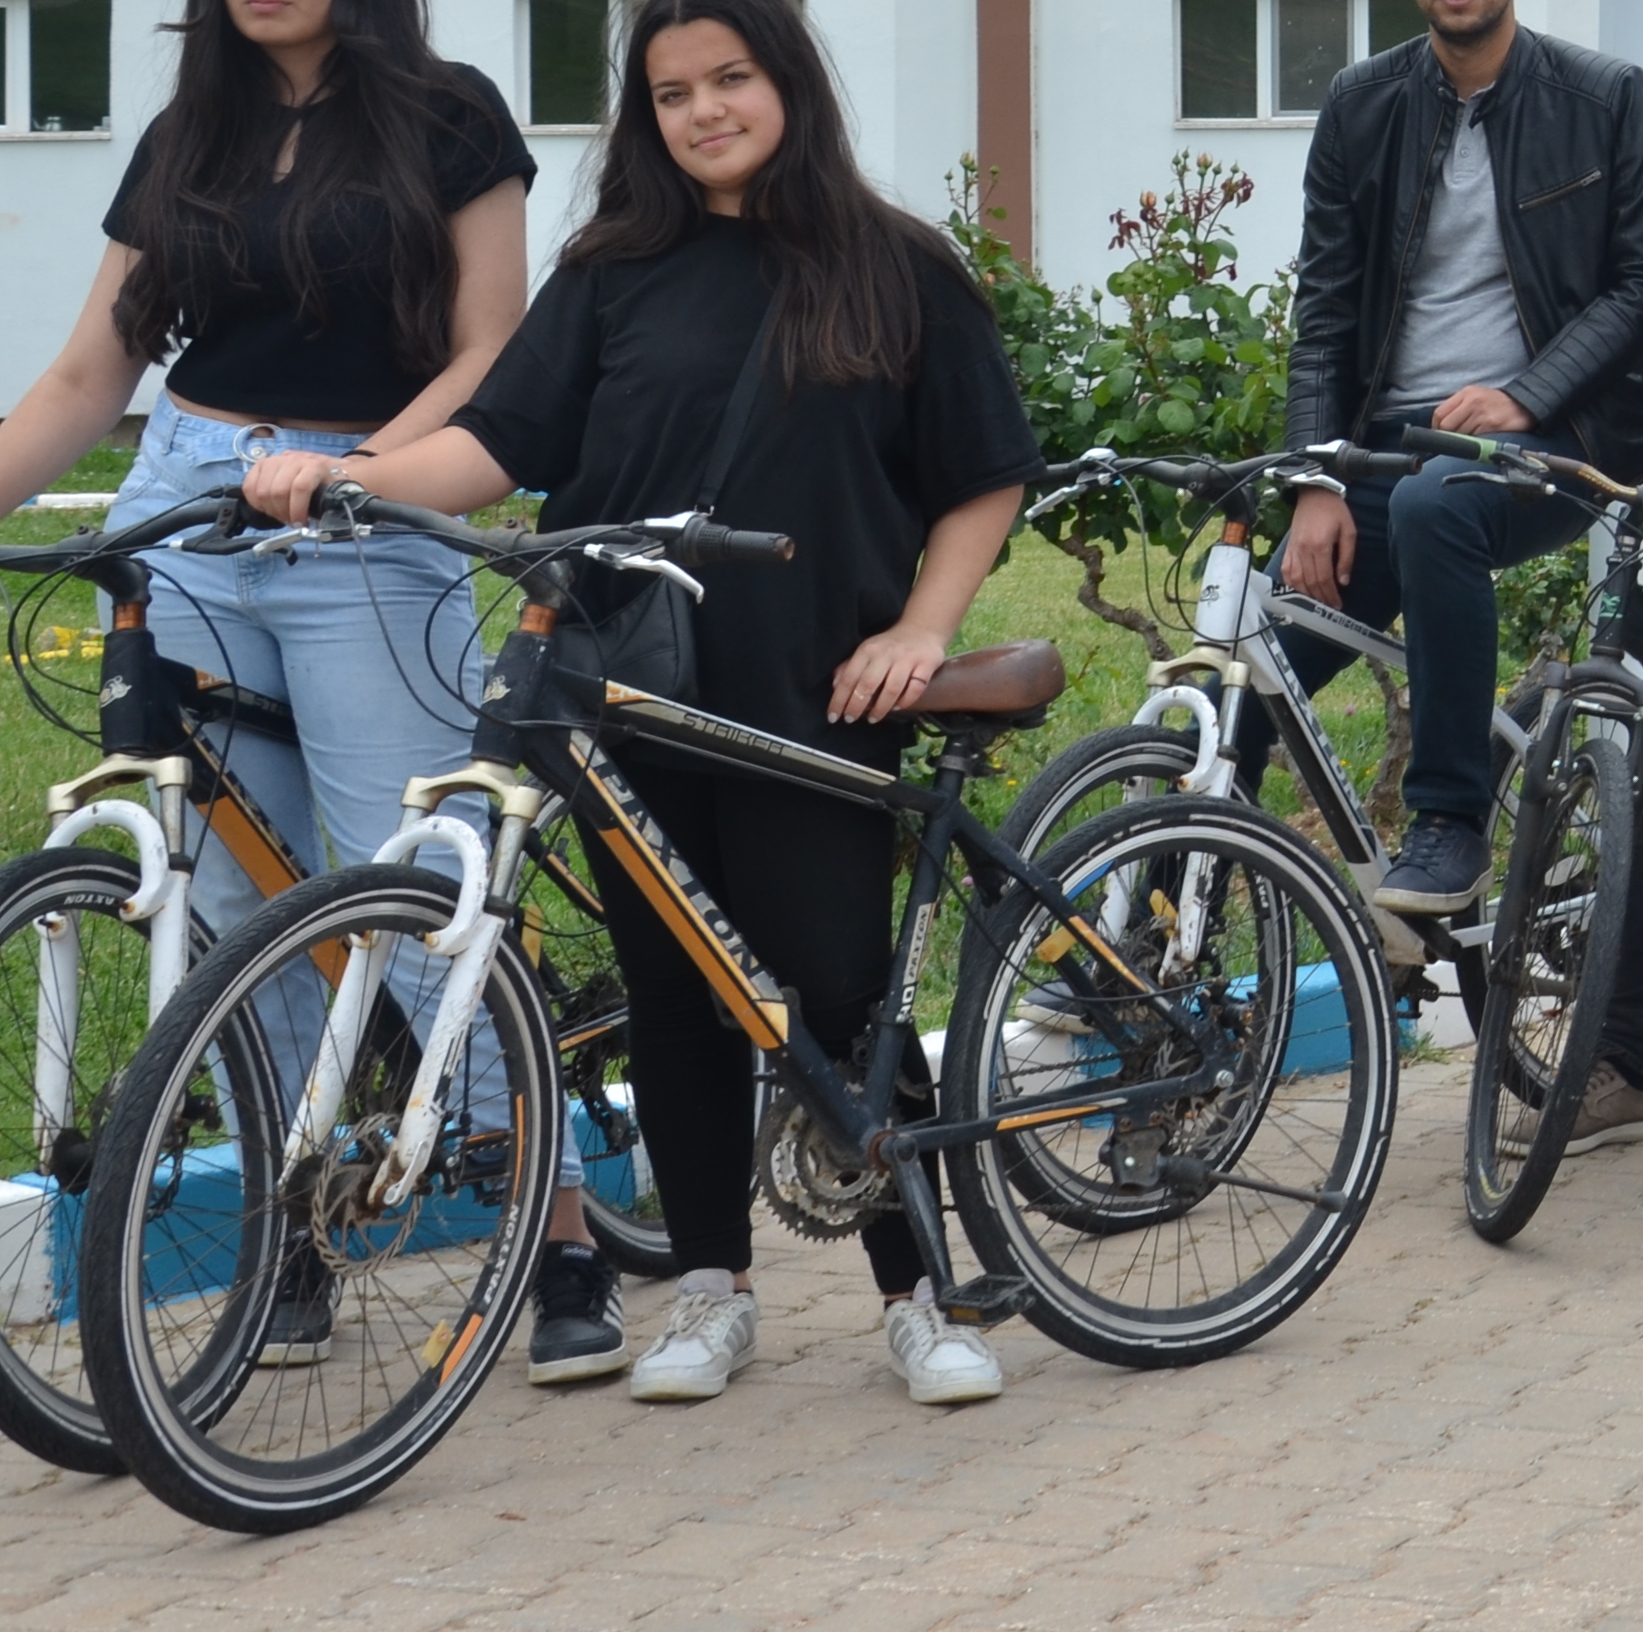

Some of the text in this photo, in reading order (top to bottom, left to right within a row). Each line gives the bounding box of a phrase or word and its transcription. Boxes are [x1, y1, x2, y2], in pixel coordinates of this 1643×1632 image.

[63, 893, 117, 906] AXTON
[595, 760, 771, 986] PAXTON
[908, 909, 929, 979] PAXTON
